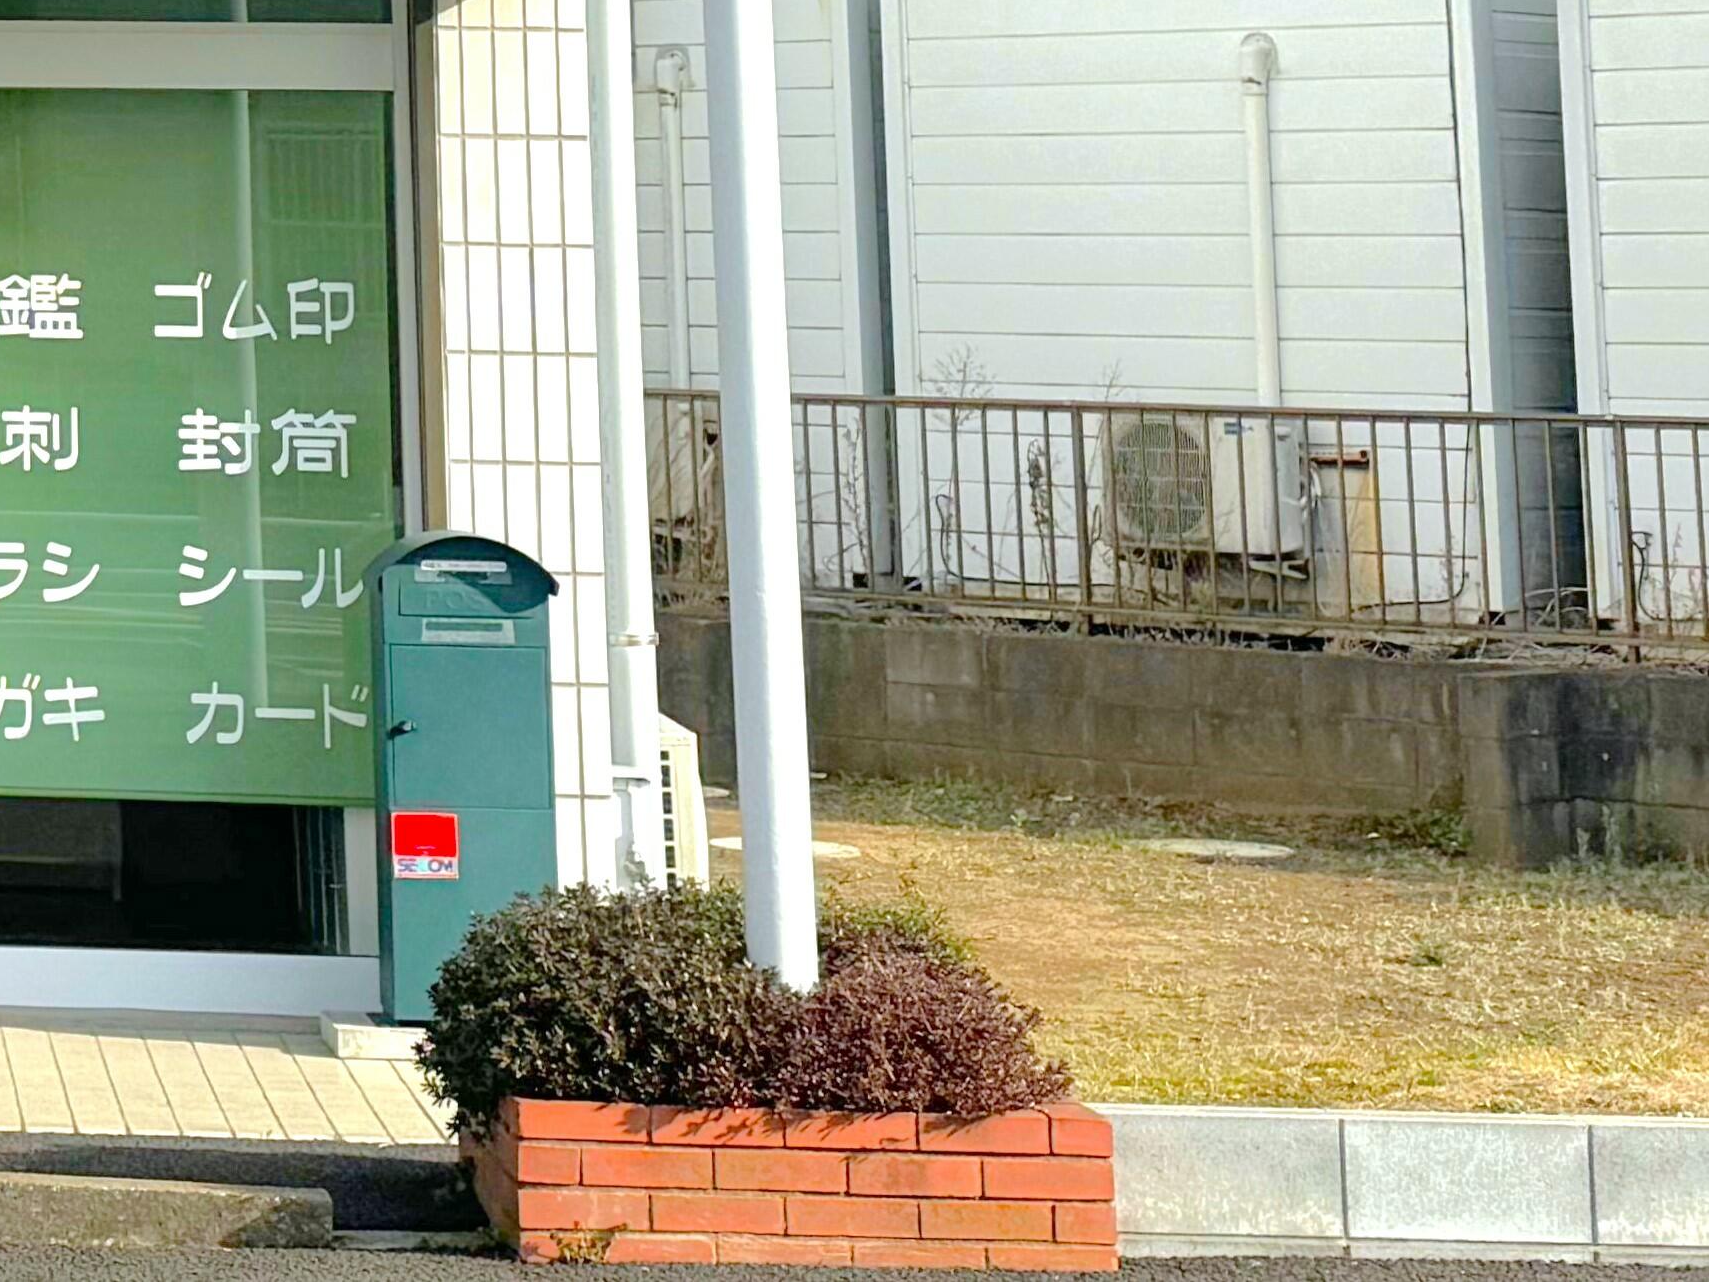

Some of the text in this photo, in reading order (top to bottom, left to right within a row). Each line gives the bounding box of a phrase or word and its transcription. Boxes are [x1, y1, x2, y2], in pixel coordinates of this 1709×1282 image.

[154, 271, 357, 345] ゴム印
[178, 405, 358, 478] 封筒
[179, 544, 365, 609] シール
[185, 680, 370, 751] カード
